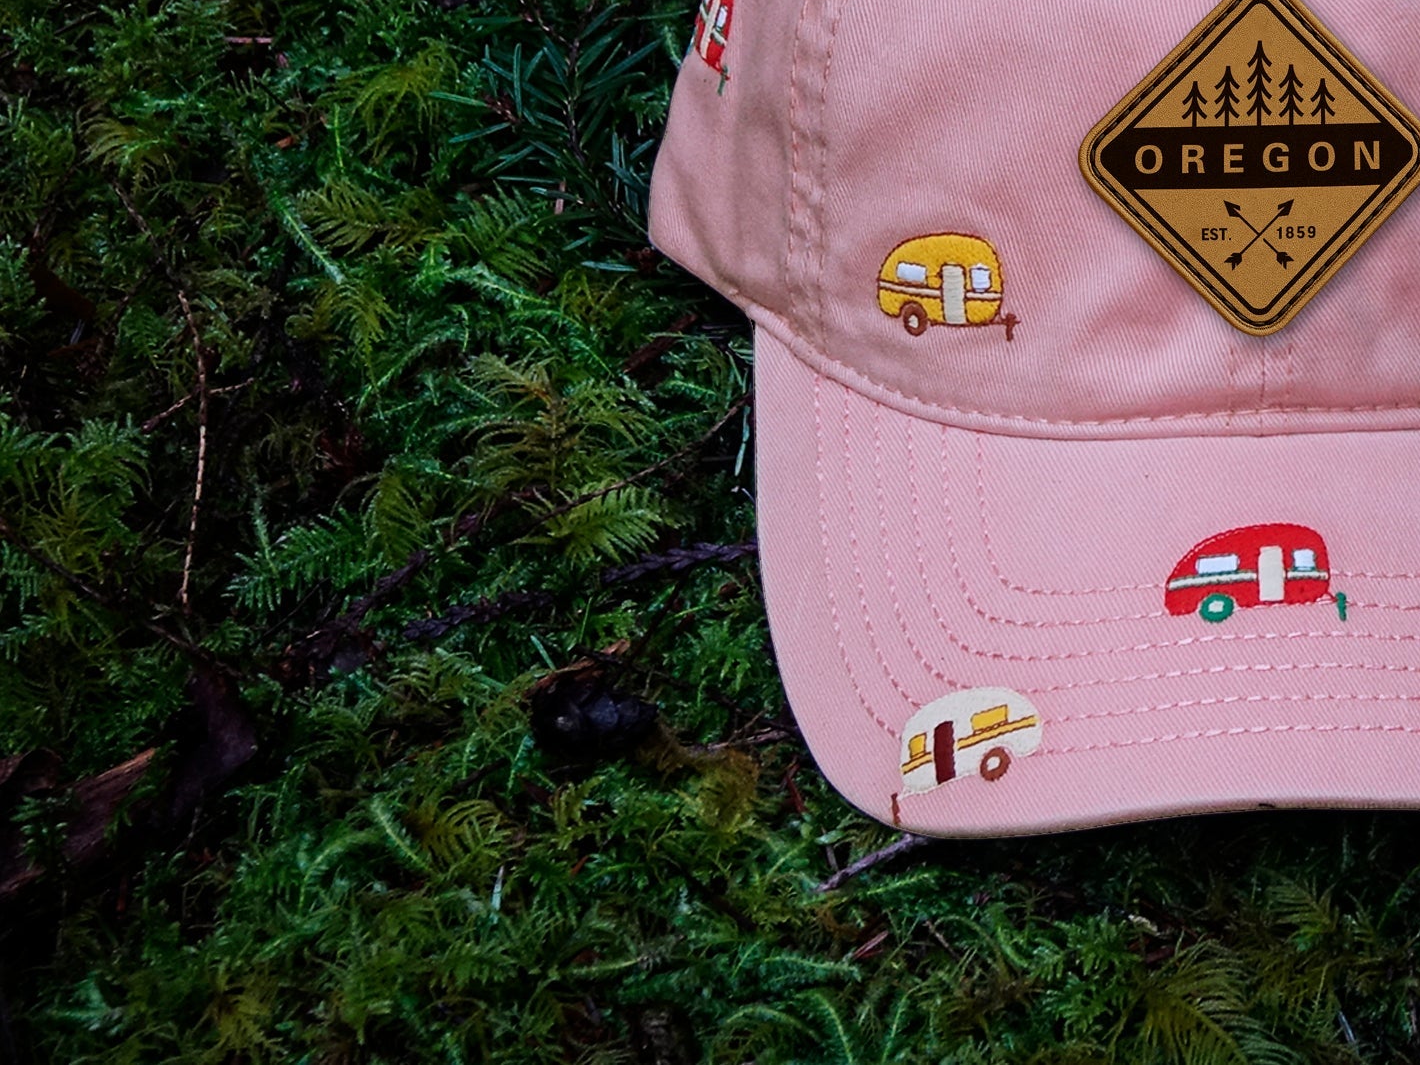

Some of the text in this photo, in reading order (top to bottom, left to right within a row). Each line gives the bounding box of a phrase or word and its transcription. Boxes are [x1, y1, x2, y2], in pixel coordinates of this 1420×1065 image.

[1134, 140, 1381, 174] OREGON
[1201, 225, 1316, 241] EST. 1859
